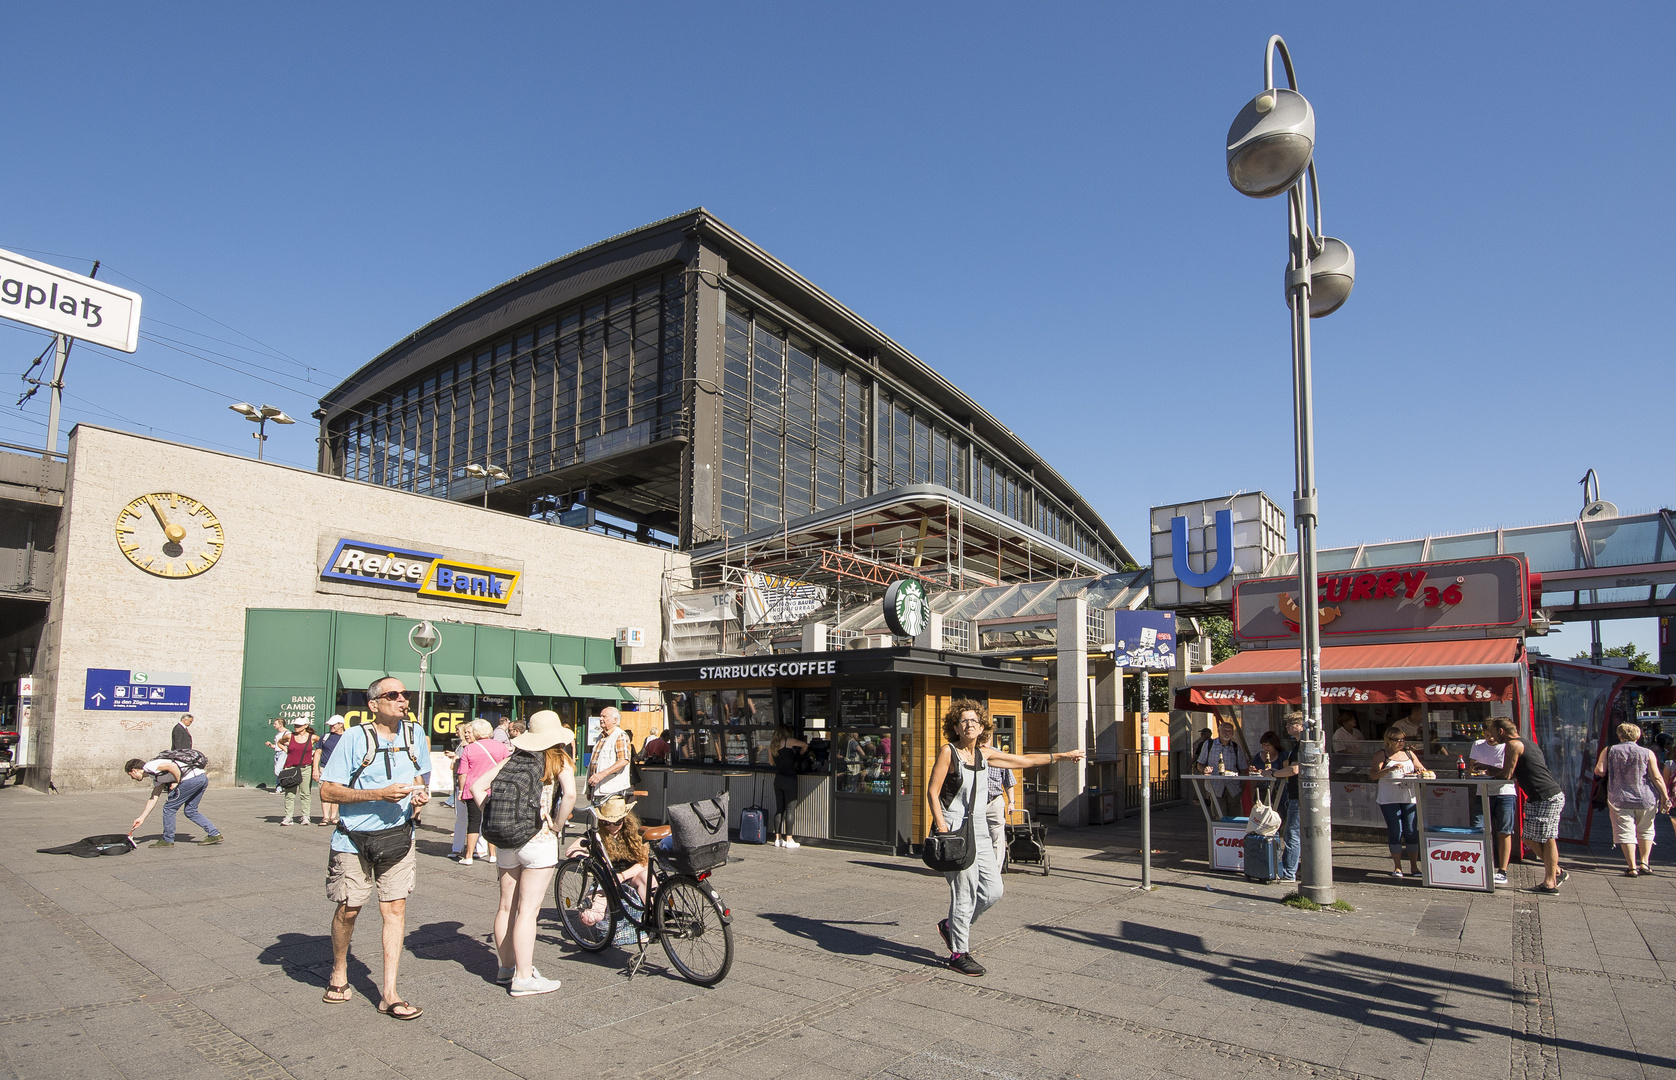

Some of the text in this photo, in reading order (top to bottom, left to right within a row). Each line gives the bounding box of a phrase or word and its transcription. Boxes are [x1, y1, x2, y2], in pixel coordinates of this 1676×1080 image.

[0, 275, 102, 328] gplatz
[1171, 509, 1234, 588] U
[340, 549, 424, 579] Reise
[437, 567, 503, 595] Bank
[700, 660, 836, 680] STARBUCKS COFFEE
[1204, 689, 1255, 703] CURRY 36
[1320, 687, 1369, 701] URRY 36
[1424, 684, 1492, 699] CURRY 36
[291, 695, 316, 703] BANK
[280, 703, 316, 711] CAMBIO
[343, 710, 465, 735] CHGE
[1215, 837, 1244, 848] CURR
[1430, 849, 1481, 863] CURRY
[1460, 865, 1476, 874] 36
